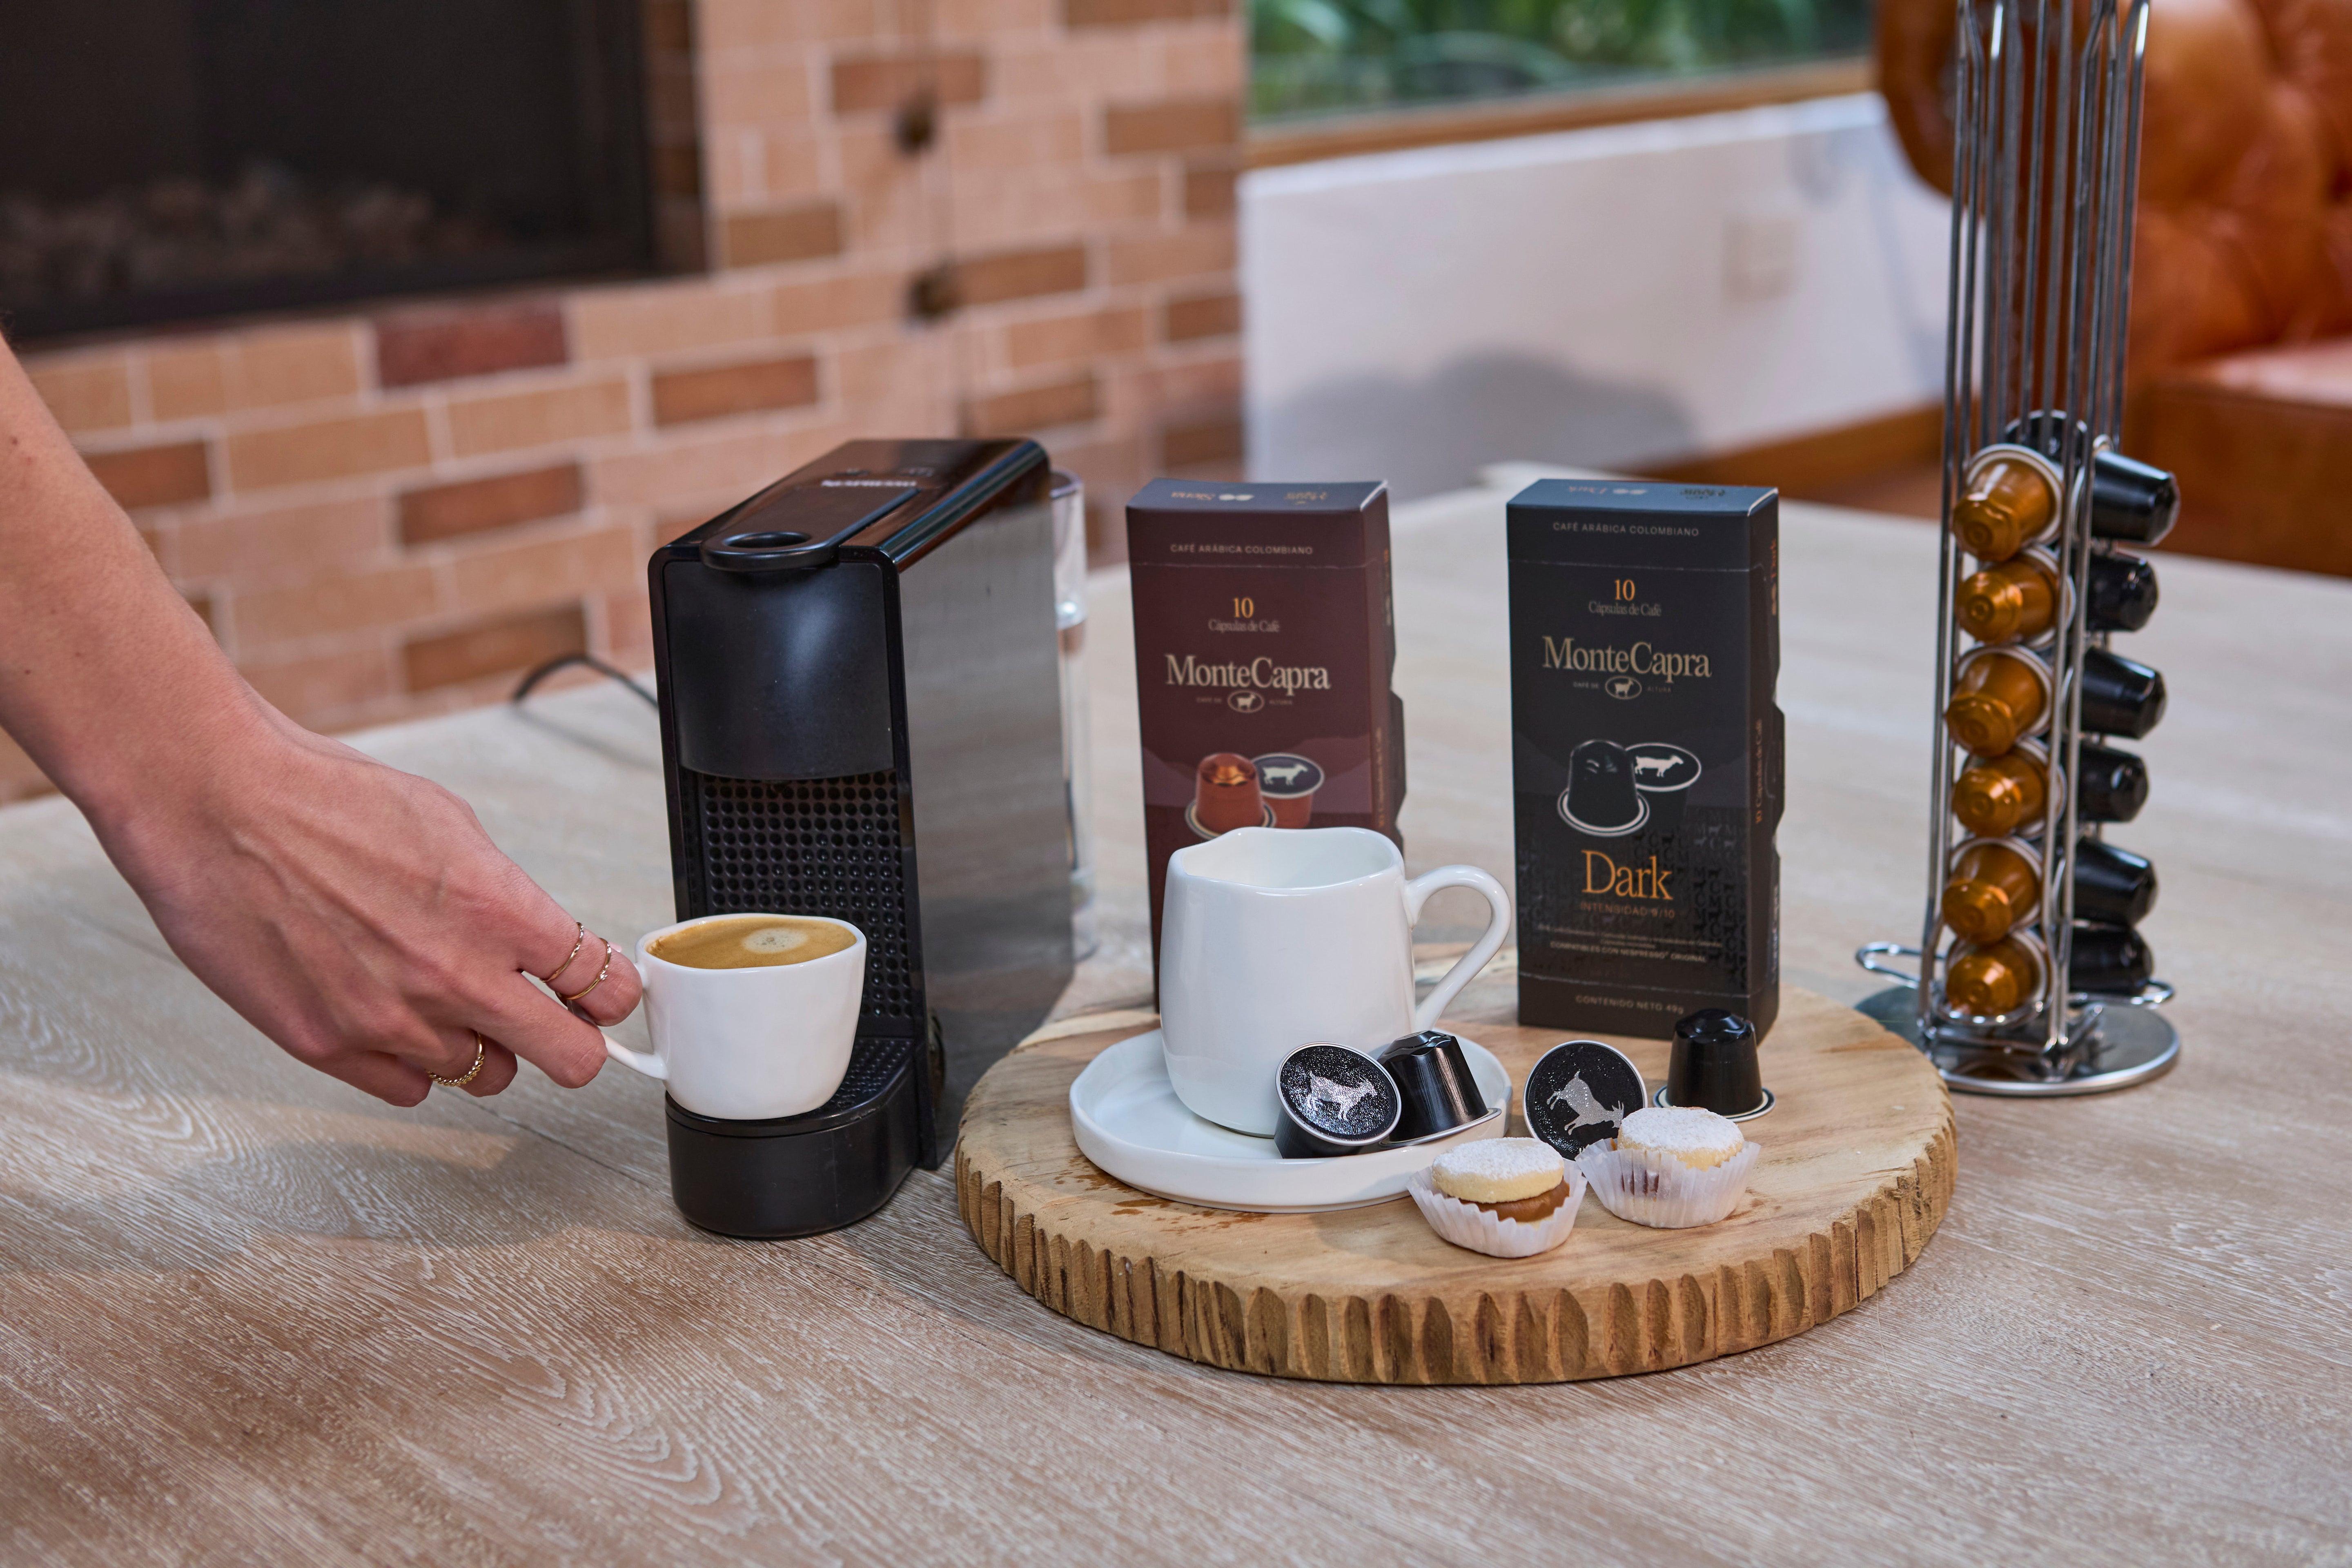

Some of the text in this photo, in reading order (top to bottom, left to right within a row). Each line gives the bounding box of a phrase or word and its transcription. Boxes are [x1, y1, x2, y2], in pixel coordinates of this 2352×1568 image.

[1553, 521, 1699, 536] CAFÉ ARÁBICA COLOMBIANO
[1170, 543, 1313, 555] CAFÉ ARÁBICA COLOMBIANO
[1615, 579, 1635, 601] 10
[1233, 597, 1254, 618] 10
[1628, 604, 1639, 615] de
[1641, 604, 1661, 616] Café
[1542, 636, 1712, 683] MonteCapra
[1165, 653, 1331, 696] MonteCapra
[1581, 850, 1673, 900] Dark
[1581, 901, 1648, 916] INTENSIDAD
[1670, 953, 1706, 962] ORIGINAL
[1576, 995, 1634, 1009] CONTENIDO
[1637, 1001, 1662, 1011] NETO
